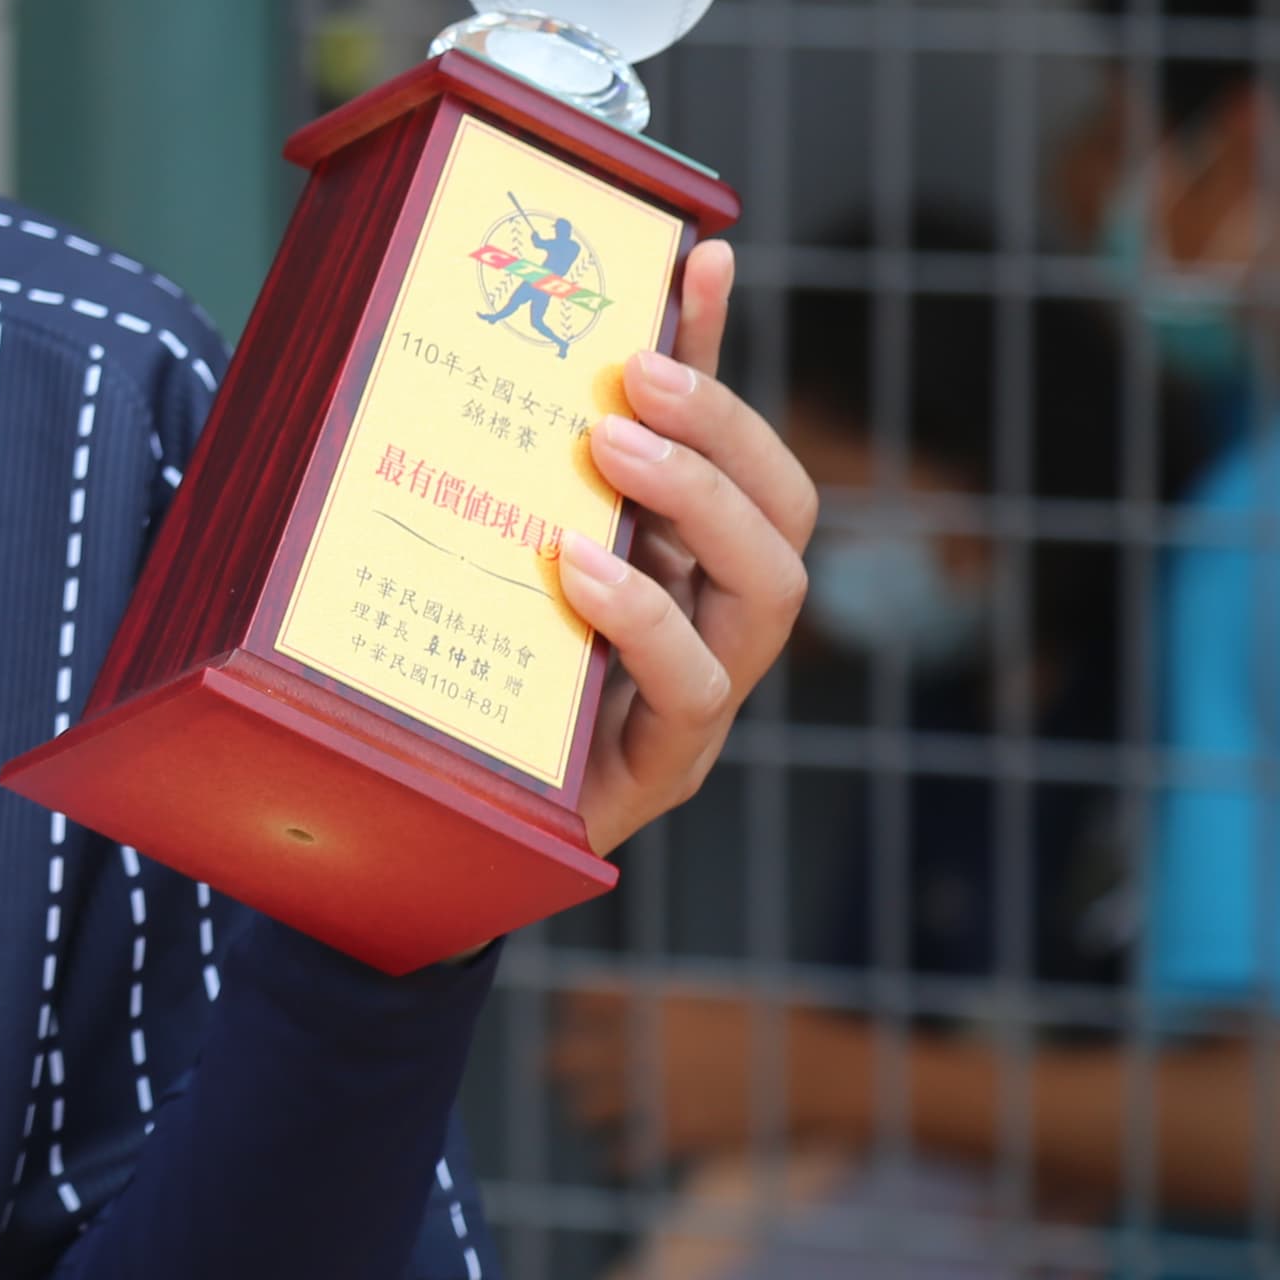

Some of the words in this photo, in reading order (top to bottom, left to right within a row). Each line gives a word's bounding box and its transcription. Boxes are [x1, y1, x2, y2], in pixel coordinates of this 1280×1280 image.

[400, 330, 592, 440] 110年全國女子棒
[460, 398, 539, 454] 錦標賽
[355, 566, 536, 669] 中華民國棒球協會
[351, 634, 509, 724] 中華民國110年8月
